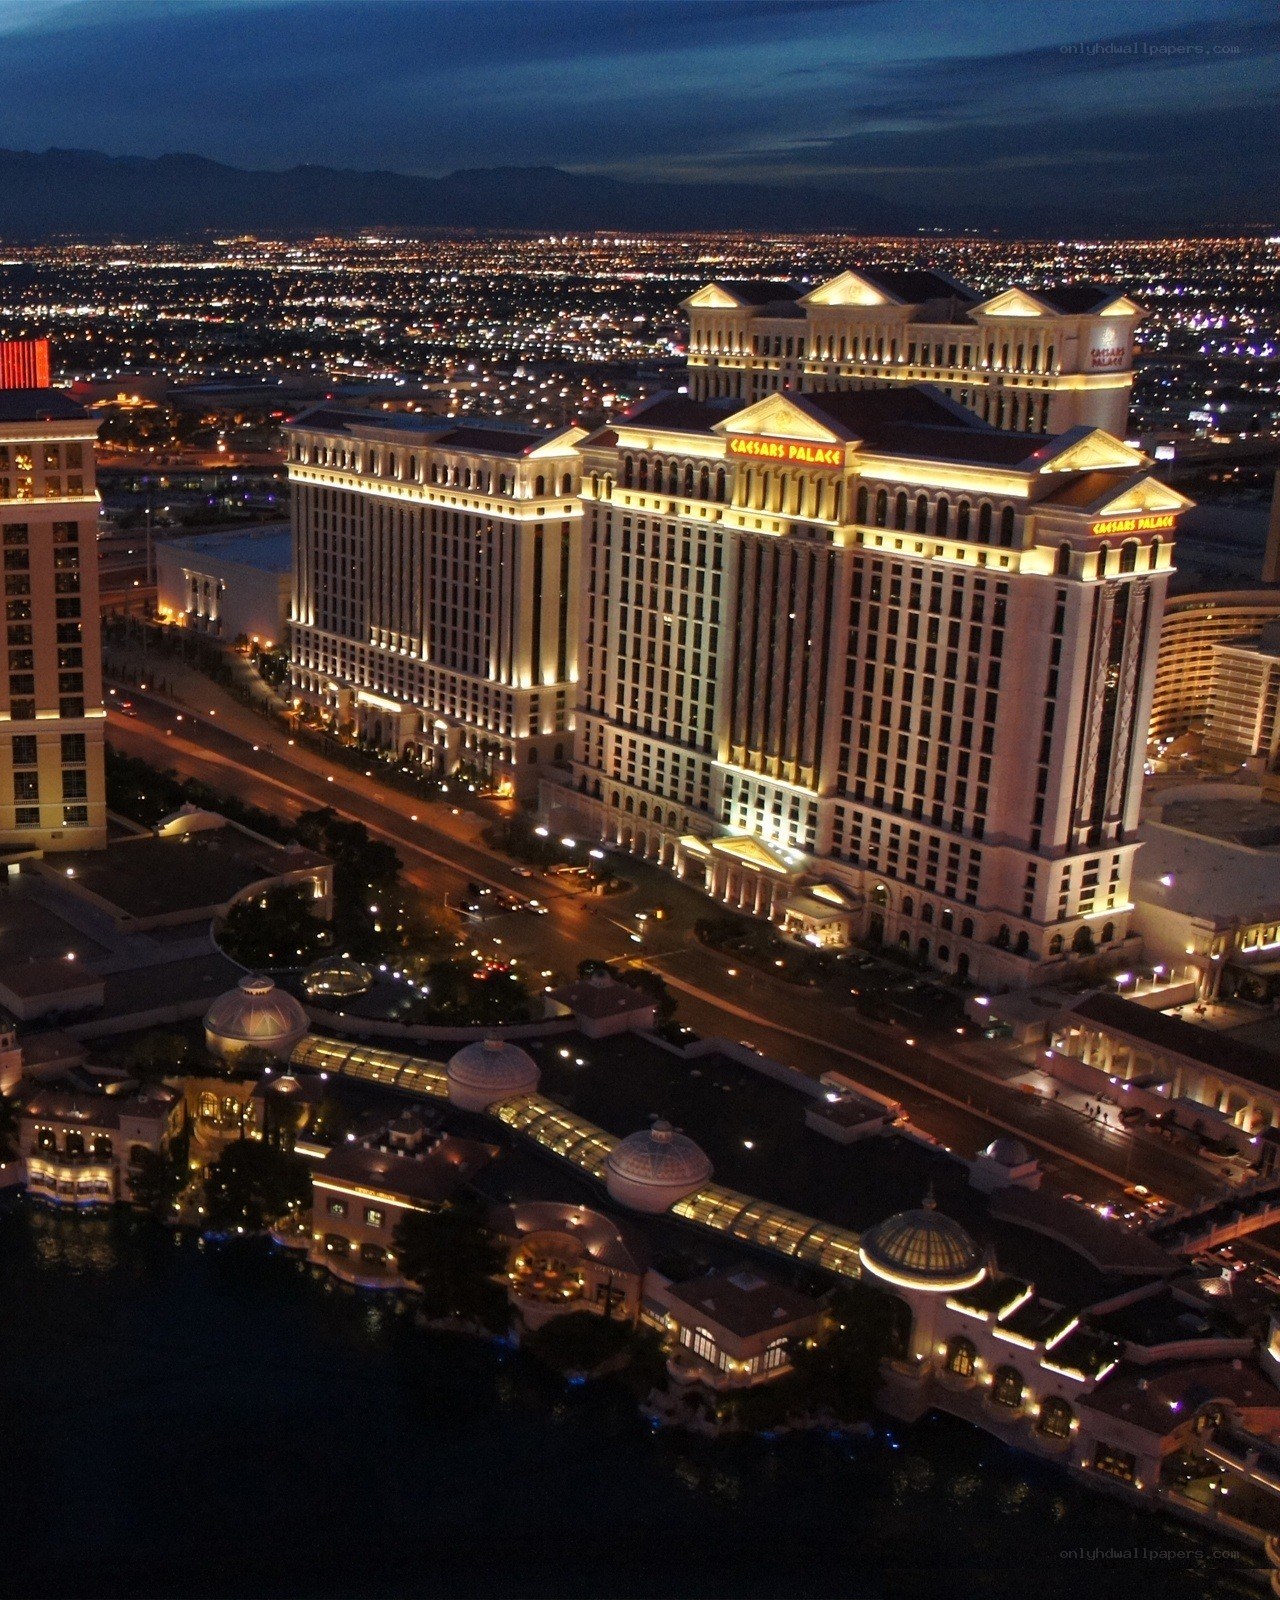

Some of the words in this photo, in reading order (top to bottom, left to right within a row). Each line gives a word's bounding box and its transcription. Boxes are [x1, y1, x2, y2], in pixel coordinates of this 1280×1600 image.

[731, 439, 784, 458] CAESARS
[789, 446, 840, 465] PALACE
[1093, 519, 1136, 535] CAESARS
[1138, 515, 1174, 530] PALACE
